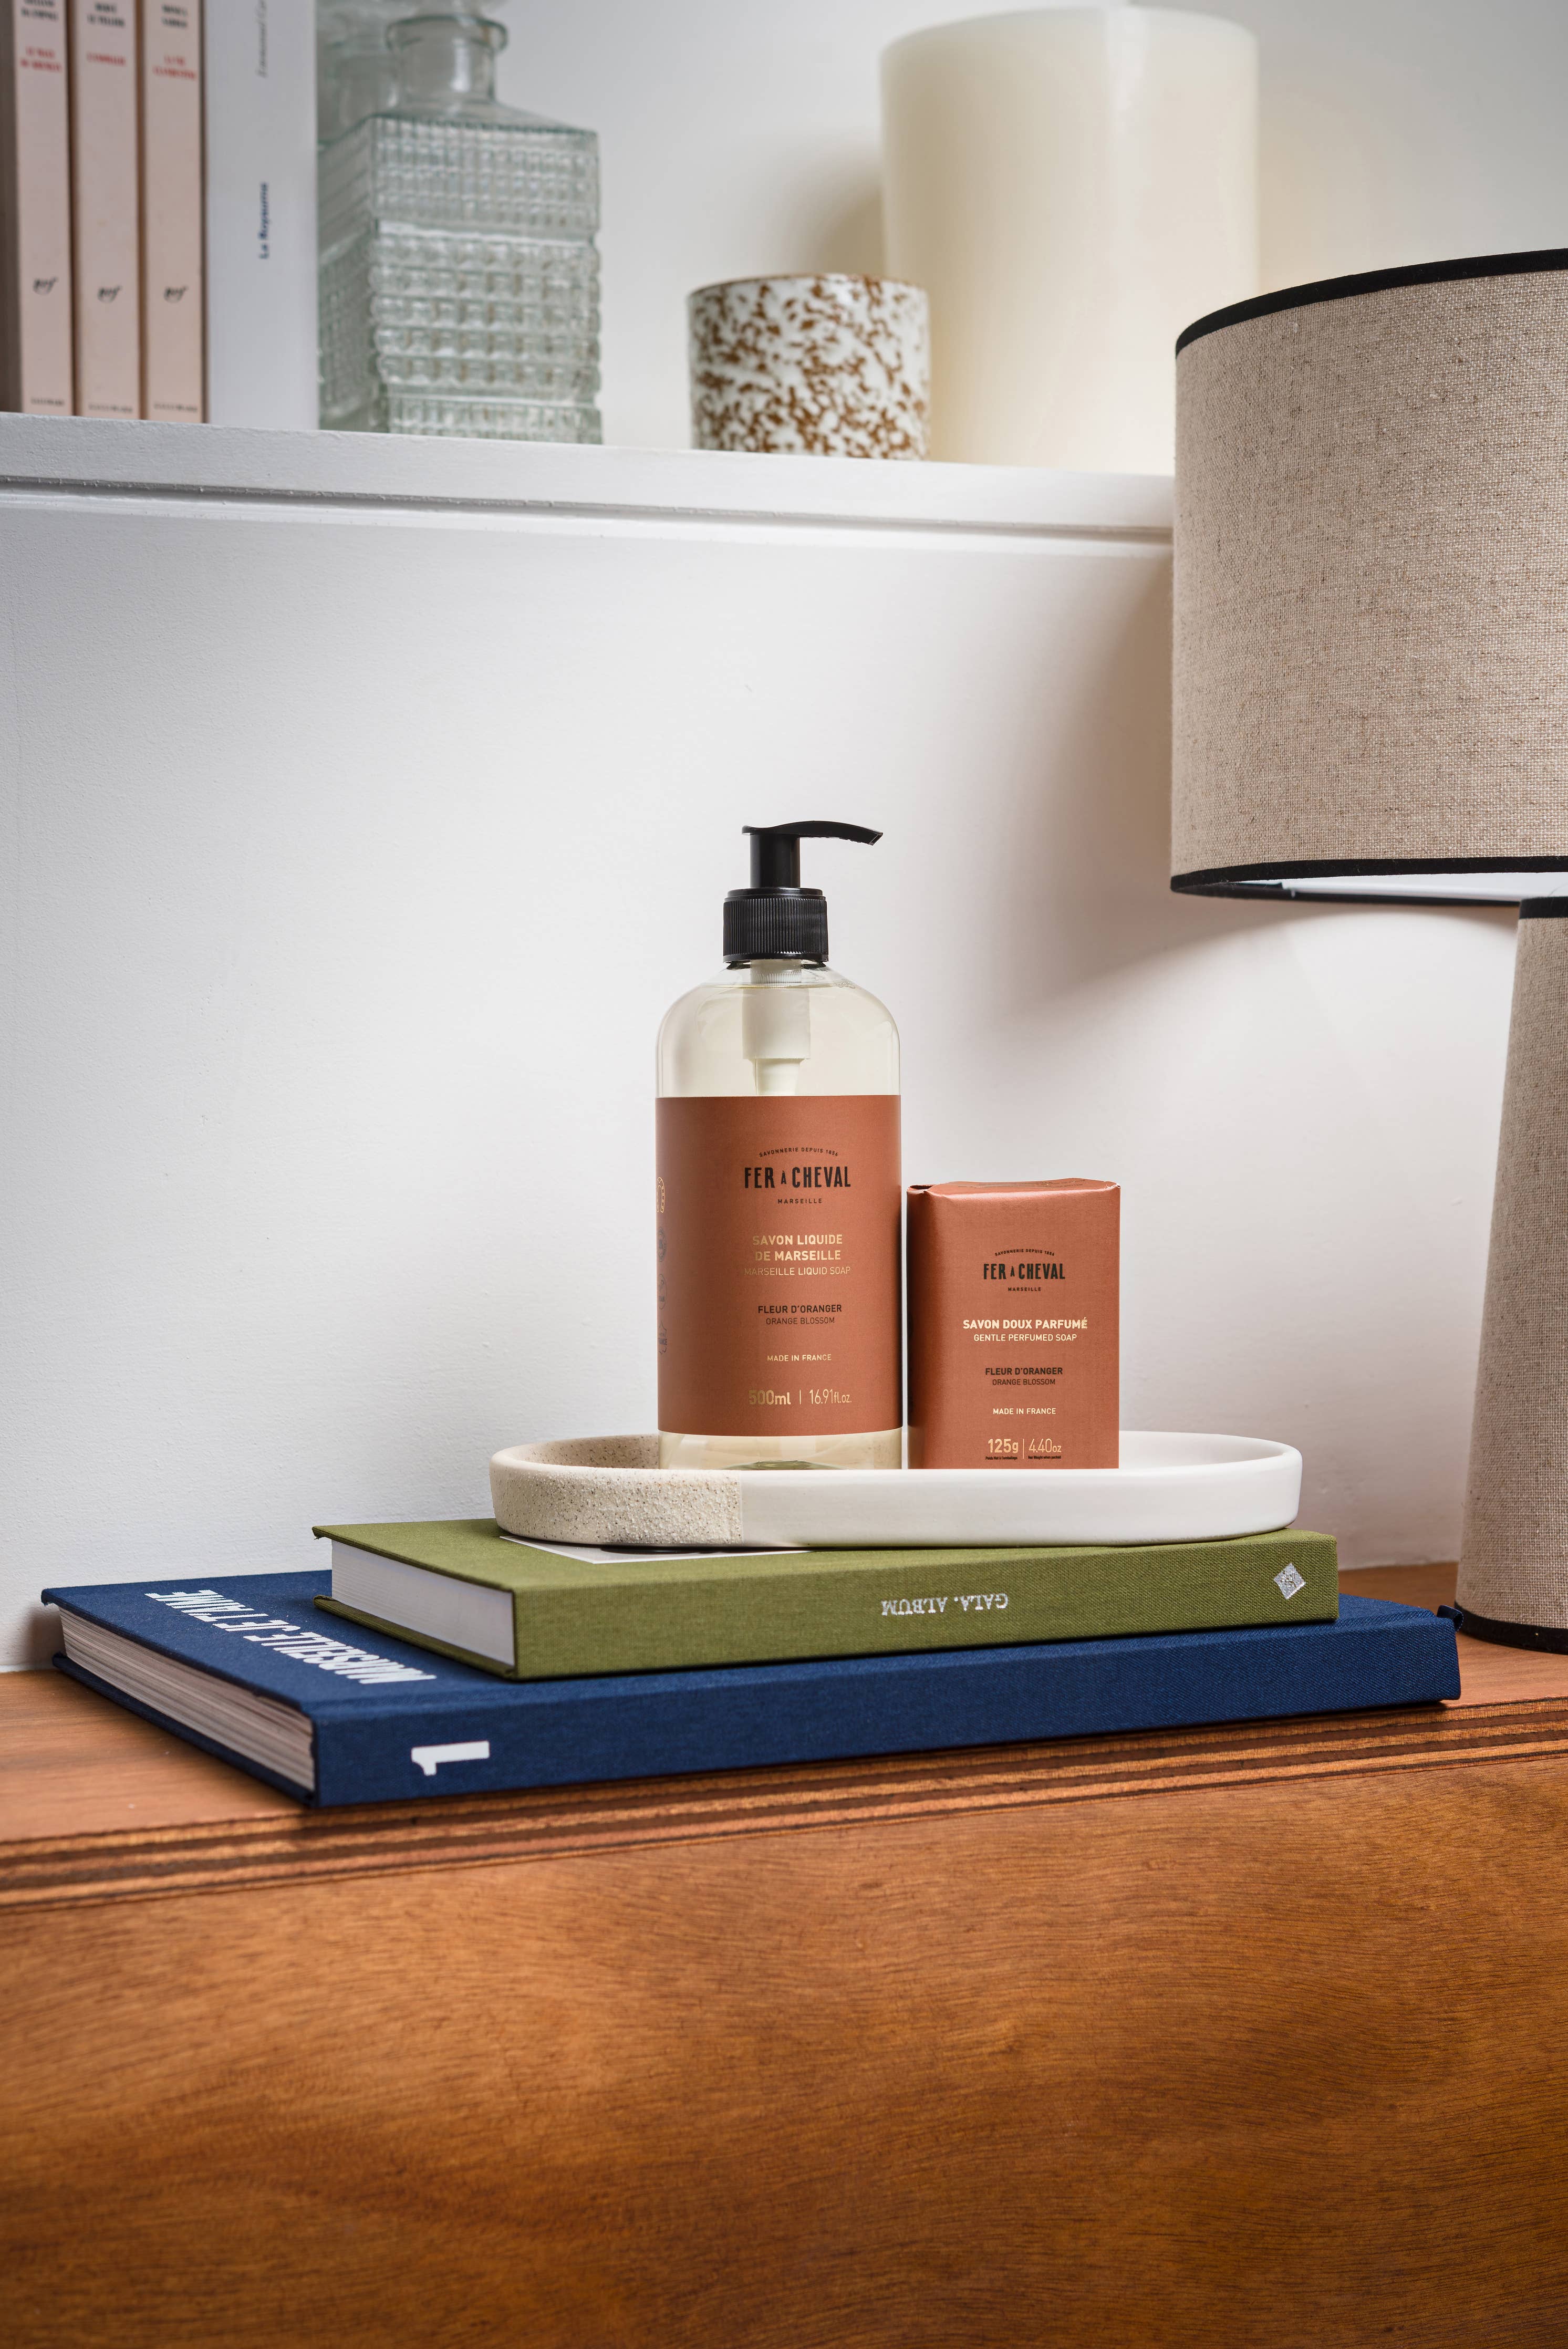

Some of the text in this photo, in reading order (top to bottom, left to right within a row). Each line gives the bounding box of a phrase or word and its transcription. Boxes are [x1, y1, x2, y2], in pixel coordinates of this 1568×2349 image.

[759, 1147, 798, 1157] SAVONNERIE
[744, 1167, 775, 1188] FER
[792, 1166, 851, 1188] CHEVAL
[752, 1234, 843, 1245] SAVON LIQUIDE
[755, 1250, 841, 1261] DE MARSEILLE
[744, 1266, 851, 1275] MARSEILLE LIQUID SOAP
[983, 1263, 1006, 1280] FER
[1019, 1263, 1065, 1280] CHEVAL
[791, 1304, 842, 1313] D'ORANGER
[963, 1317, 1088, 1329] SAVON DOUX PARFUMÉ
[749, 1389, 791, 1405] 500ml
[988, 1438, 1019, 1453] 125g
[881, 1596, 948, 1616] ALBUM
[212, 1619, 300, 1631] JE
[243, 1631, 437, 1684] MARSEILLE
[411, 1740, 490, 1775] 1
